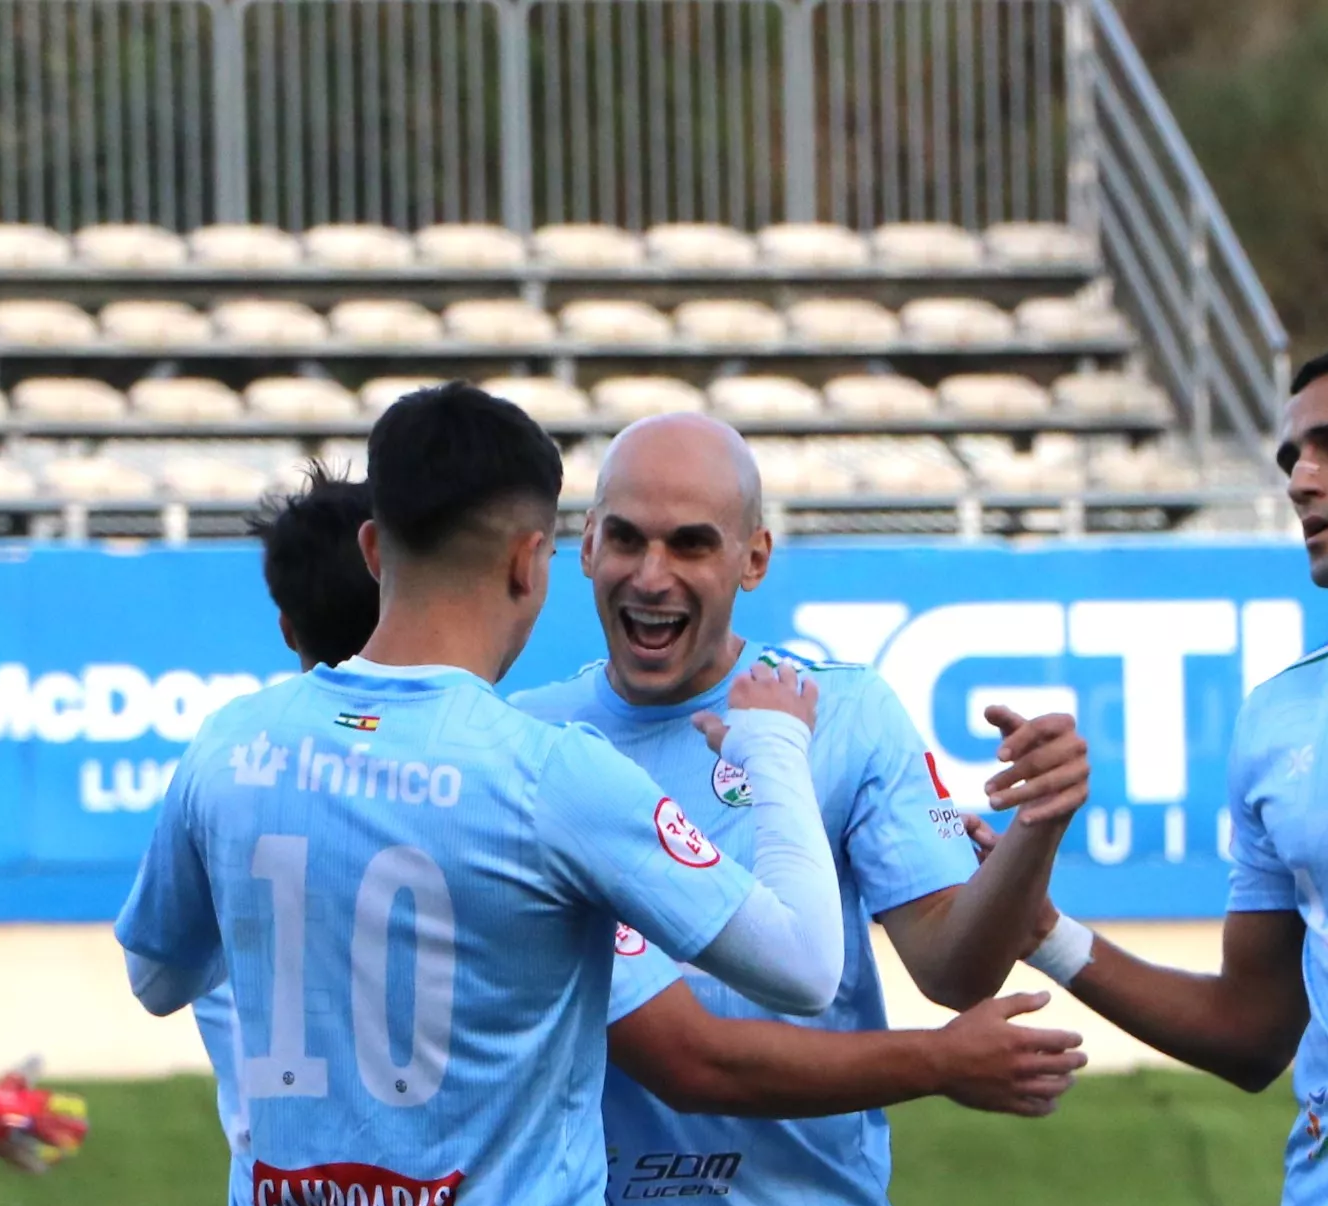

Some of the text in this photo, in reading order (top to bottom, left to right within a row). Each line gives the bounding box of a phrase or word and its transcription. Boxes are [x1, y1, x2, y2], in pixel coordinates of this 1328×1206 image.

[296, 736, 463, 808] Infrico
[243, 833, 456, 1107] 10
[622, 1183, 730, 1199] Lucena
[629, 1151, 743, 1182] SDM
